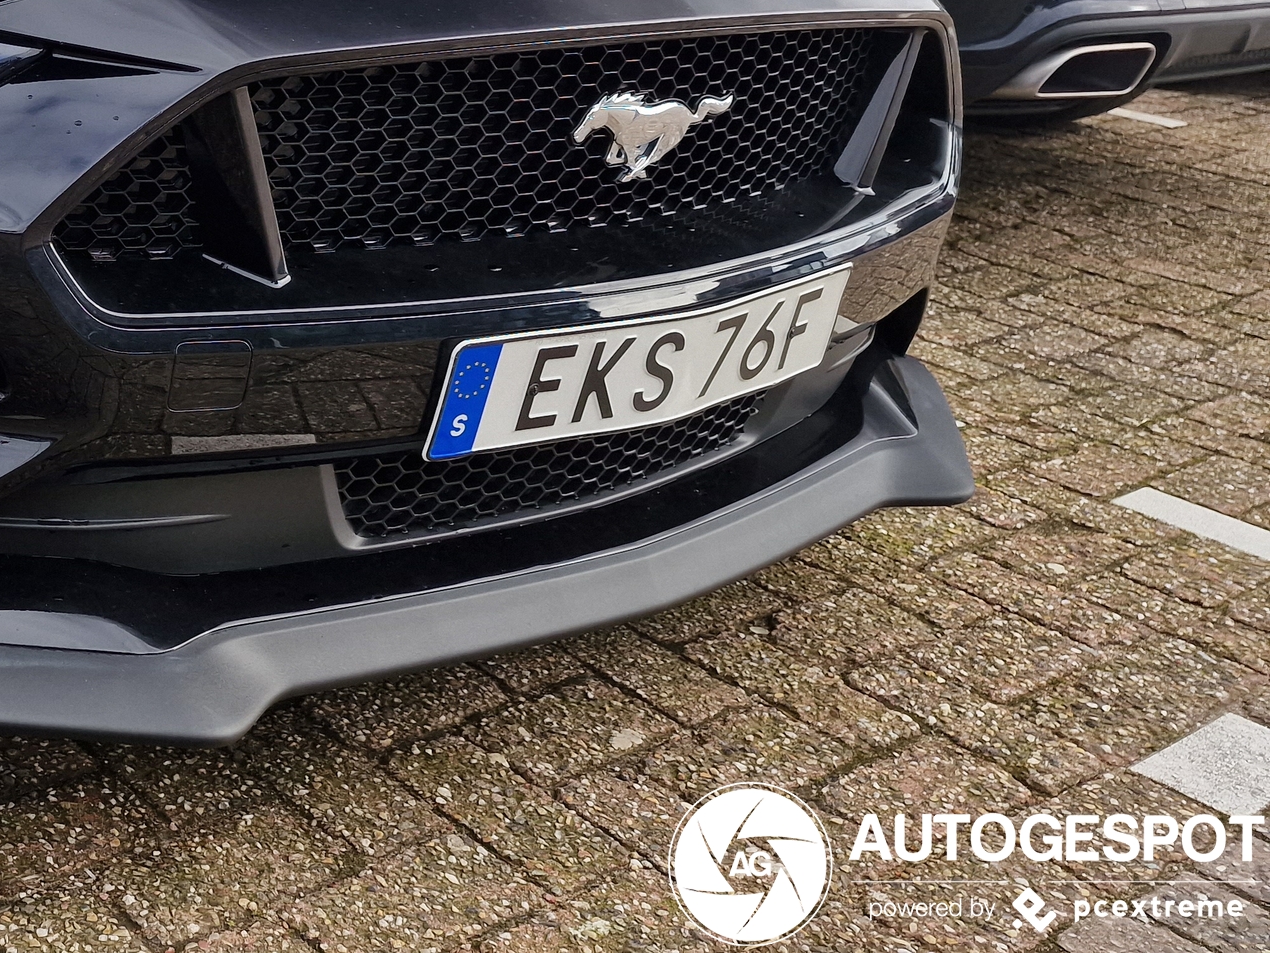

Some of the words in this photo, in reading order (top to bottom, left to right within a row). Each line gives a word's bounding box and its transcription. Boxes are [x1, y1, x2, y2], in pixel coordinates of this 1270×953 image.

[514, 330, 686, 432] EKS
[697, 287, 824, 398] 76F
[450, 414, 468, 438] S
